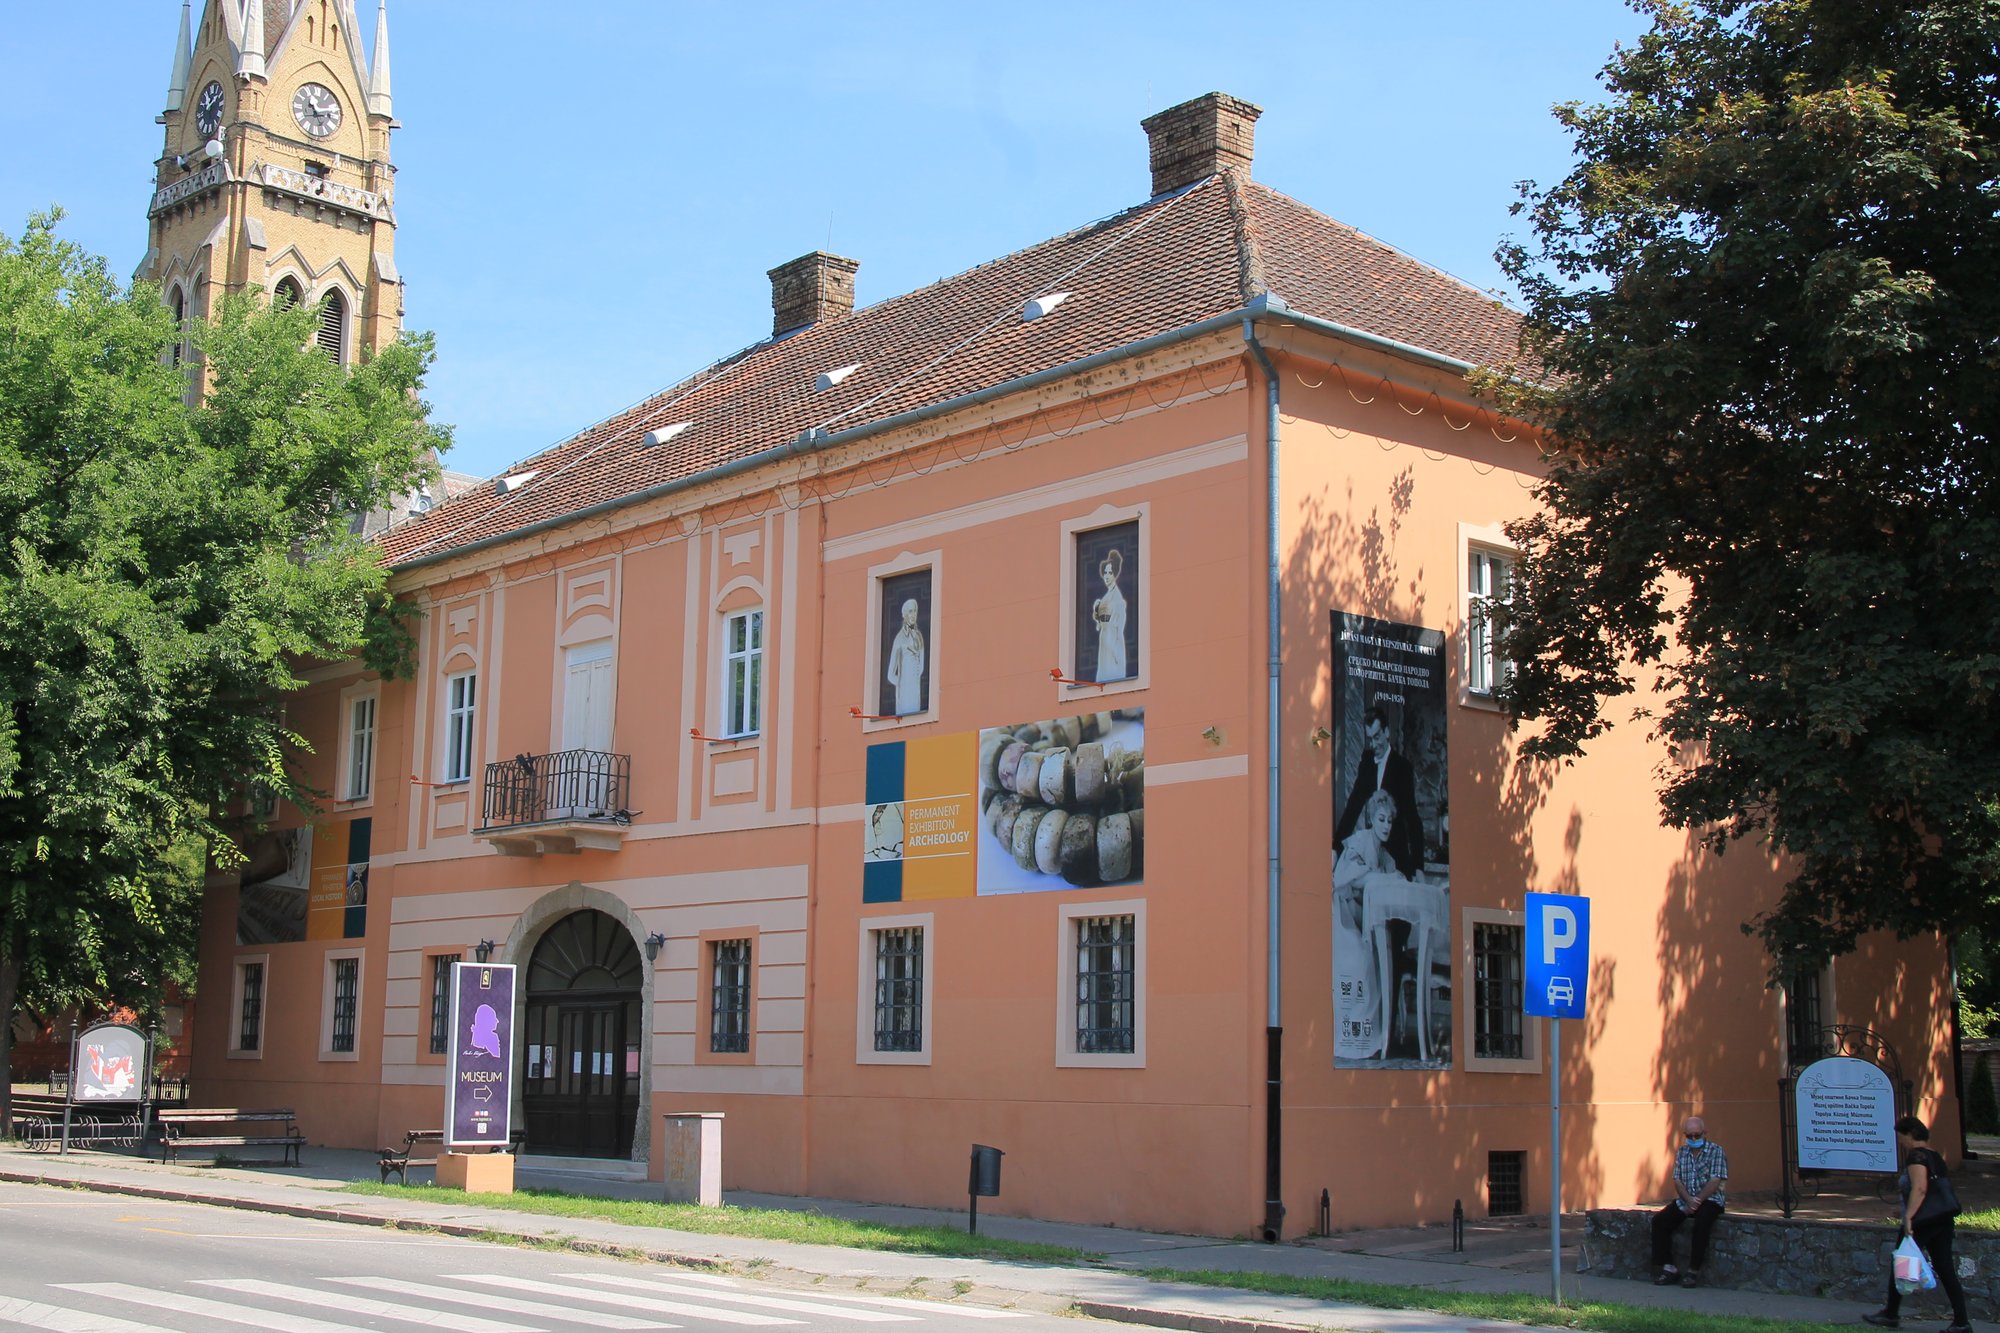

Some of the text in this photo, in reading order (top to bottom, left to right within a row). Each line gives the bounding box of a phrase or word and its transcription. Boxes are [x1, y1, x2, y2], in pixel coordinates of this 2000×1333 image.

[1388, 673, 1406, 685] БАЧКА
[1407, 677, 1430, 689] ТОПОЛА
[910, 805, 960, 820] PERMANENT
[909, 820, 955, 834] EXHIBITION
[908, 831, 970, 847] ARCHEOLOGY
[1542, 904, 1577, 965] P
[461, 1071, 502, 1083] MUSEUM
